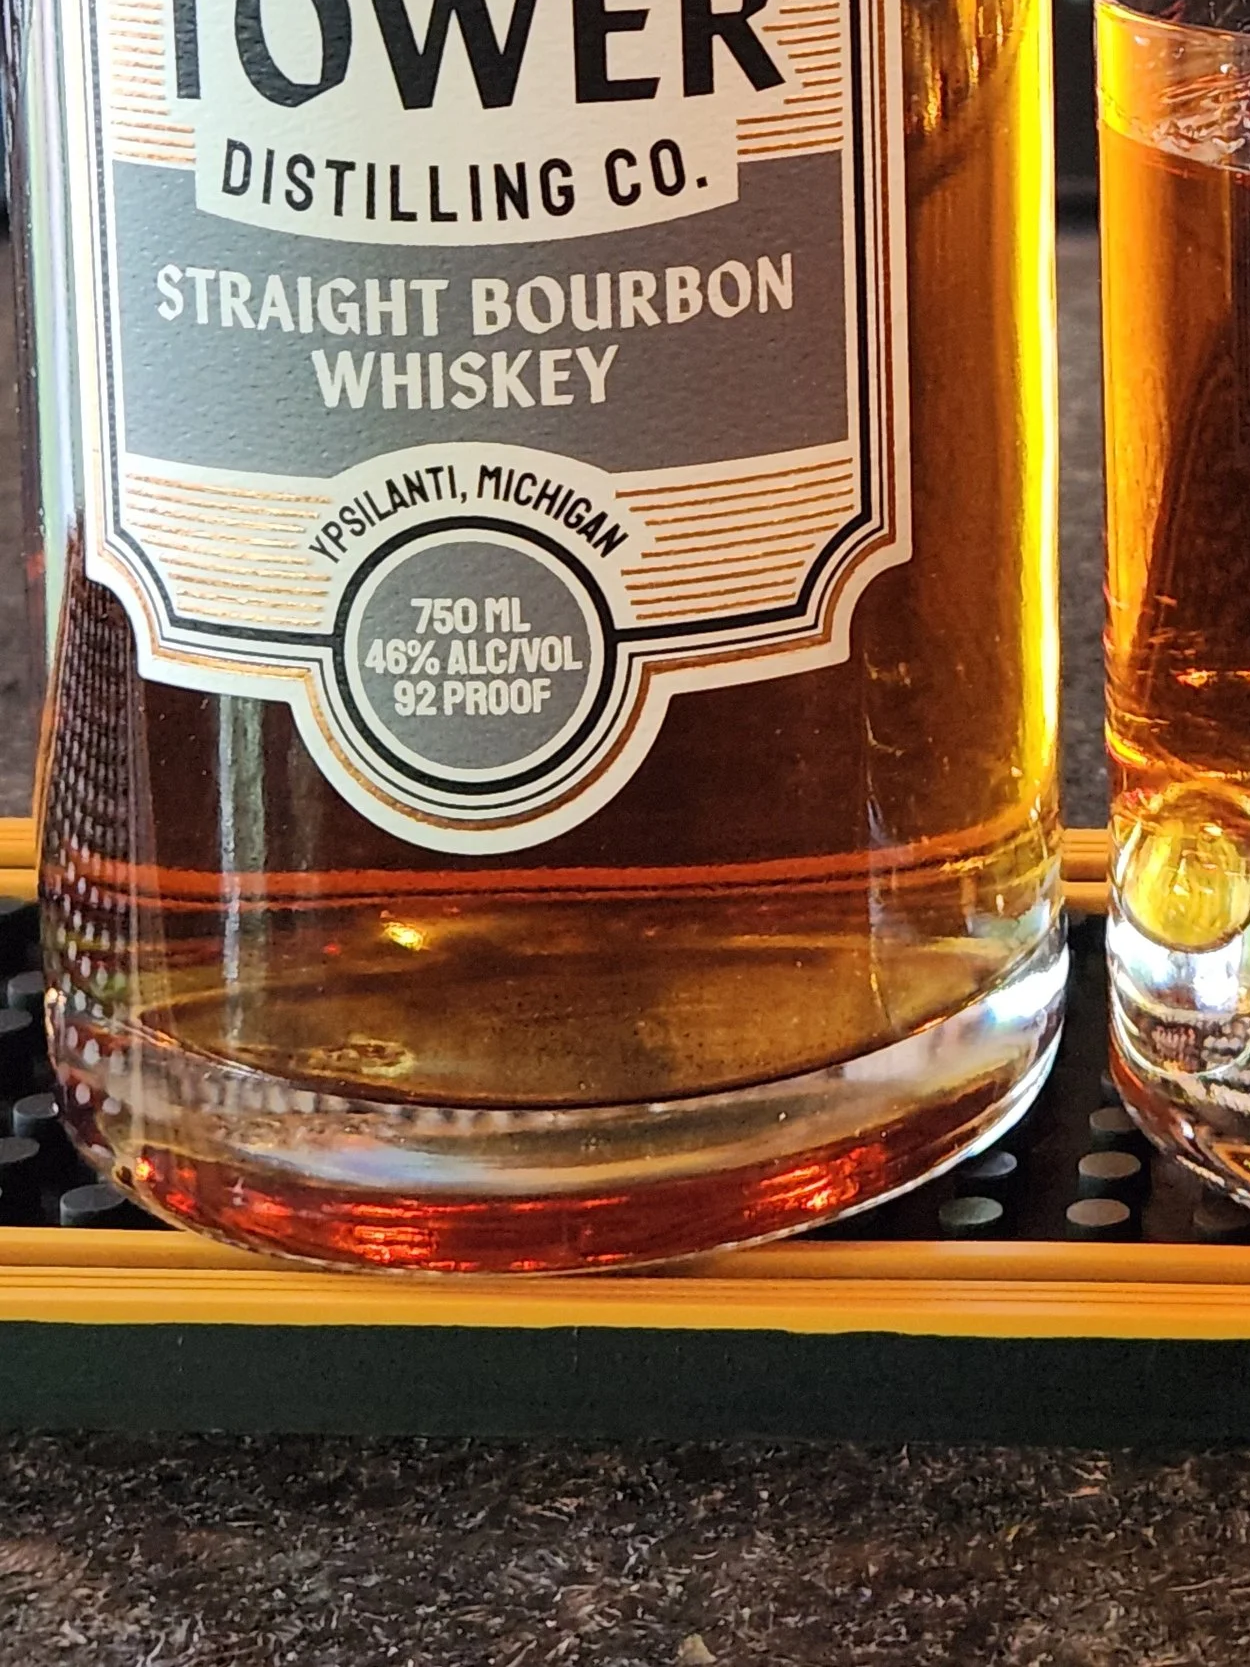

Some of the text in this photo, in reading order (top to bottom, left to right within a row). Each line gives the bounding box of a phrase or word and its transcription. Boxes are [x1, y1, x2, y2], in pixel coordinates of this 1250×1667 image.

[222, 139, 710, 222] DISTILLING CO.
[156, 253, 796, 336] STRAIGHT BOURBON
[311, 345, 618, 410] WHISKEY
[308, 465, 629, 564] YPSILANTI, MICHIGAN
[410, 595, 531, 633] 750 ML
[364, 637, 583, 675] 46% ALC/VOL
[393, 678, 552, 716] 92 PROOF
